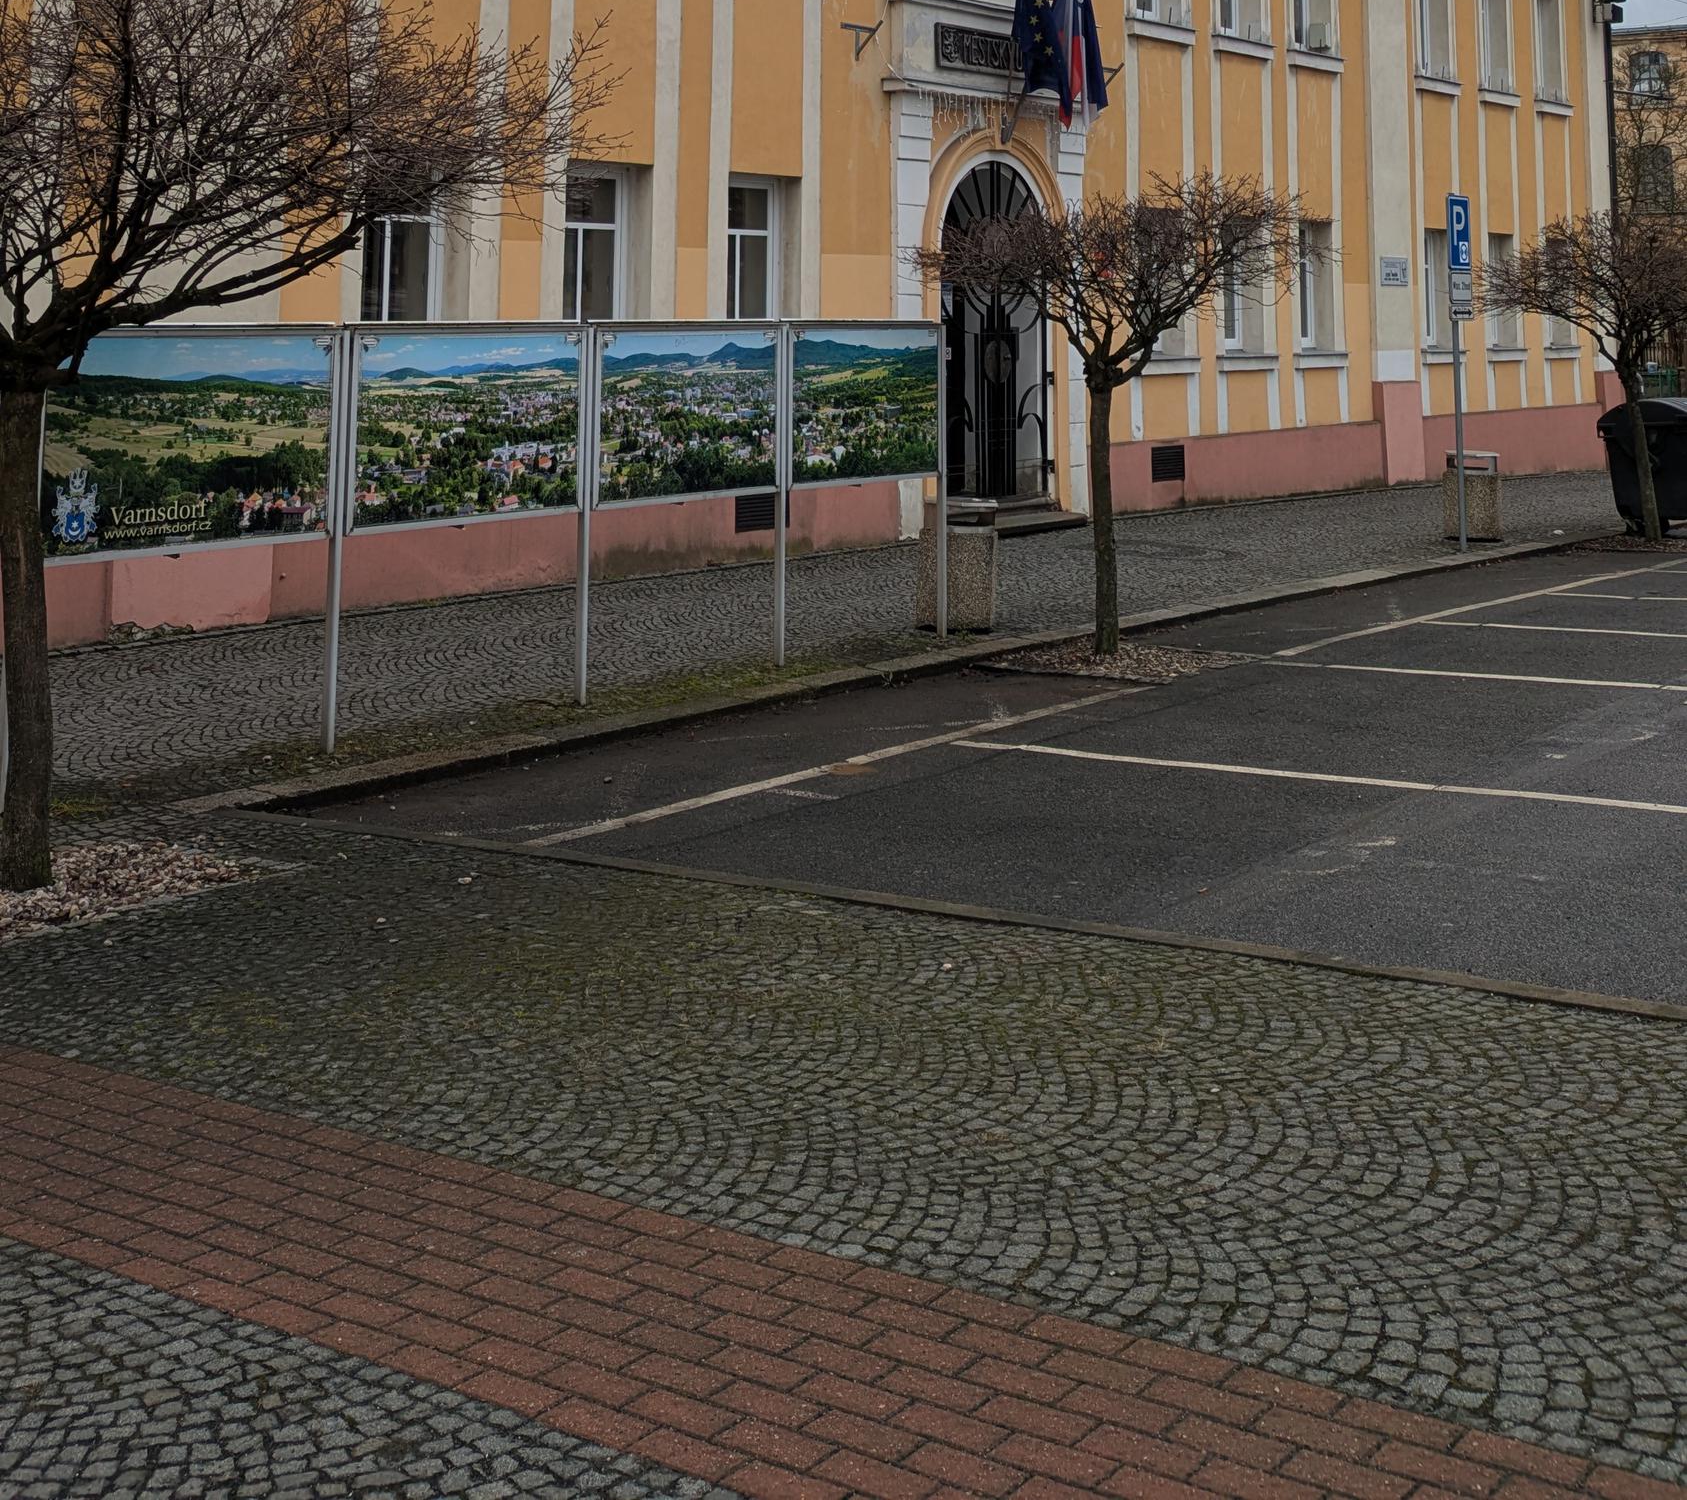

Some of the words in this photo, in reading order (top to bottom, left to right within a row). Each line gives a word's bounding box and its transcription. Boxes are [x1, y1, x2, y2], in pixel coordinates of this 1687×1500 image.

[1453, 205, 1465, 246] P
[111, 499, 209, 525] Varnsdorf
[104, 519, 212, 540] www.varnsdorf.cz
